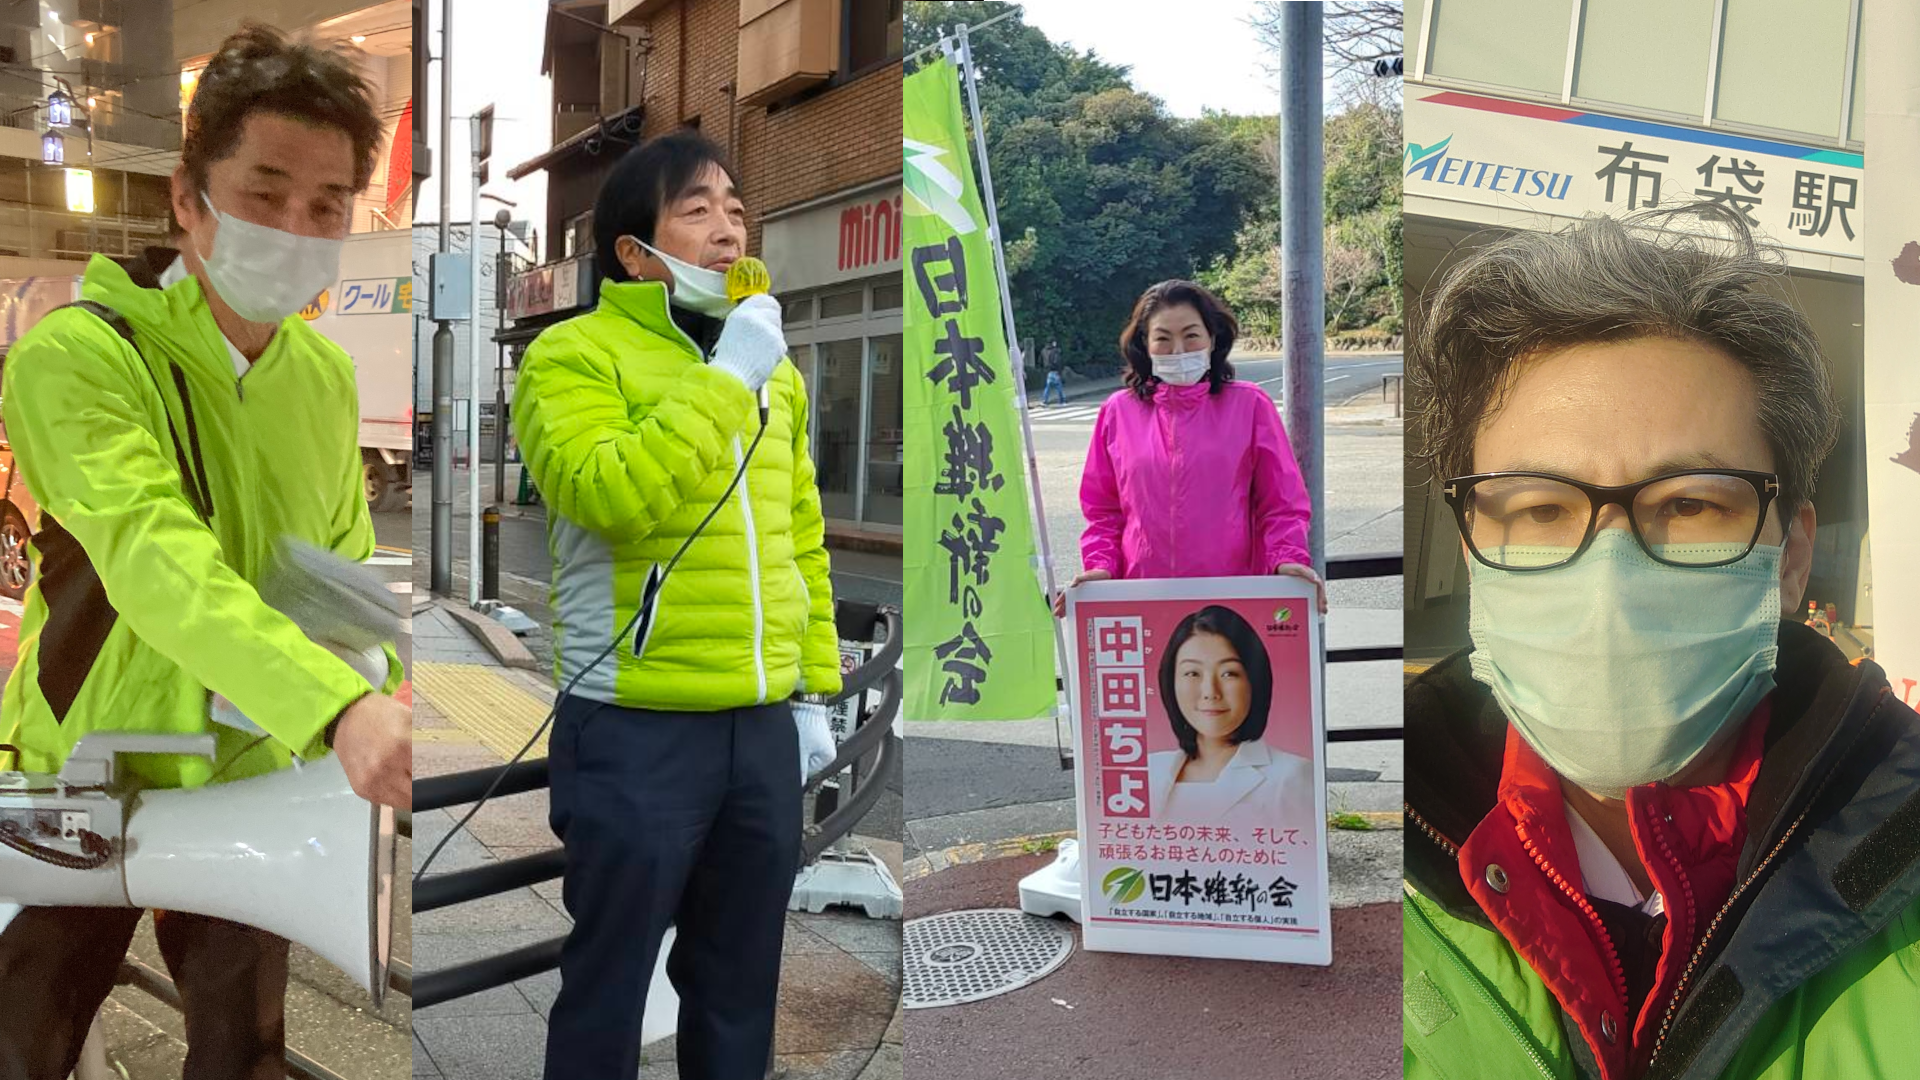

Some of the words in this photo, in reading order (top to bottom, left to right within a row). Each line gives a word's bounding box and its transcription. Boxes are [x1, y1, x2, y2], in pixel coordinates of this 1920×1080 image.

[1404, 133, 1573, 200] MEITETSU
[1595, 141, 1857, 241] 布袋駅
[838, 195, 902, 272] mini
[1100, 621, 1146, 814] 中田ちよ
[1098, 843, 1288, 866] 頑張るお母さんのために
[1149, 869, 1299, 913] 日本維新の会
